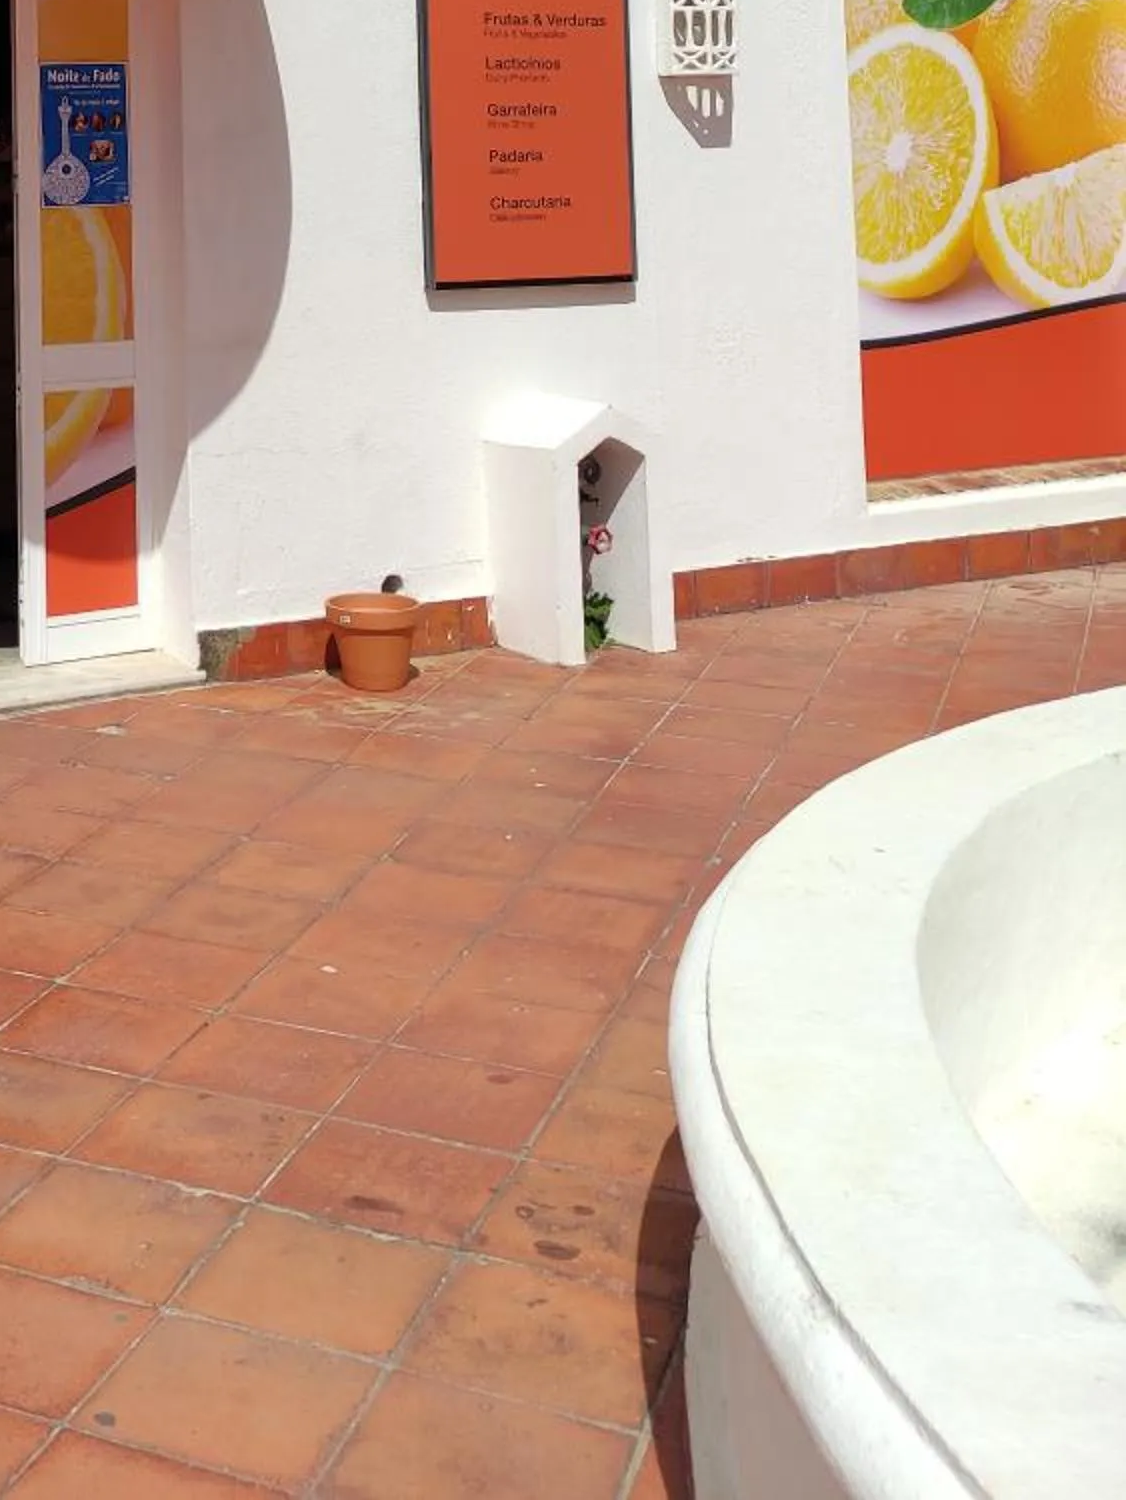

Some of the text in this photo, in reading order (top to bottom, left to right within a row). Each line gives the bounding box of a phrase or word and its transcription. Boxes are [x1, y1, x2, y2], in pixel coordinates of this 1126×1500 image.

[483, 11, 607, 28] Frutas & Verduras
[47, 69, 79, 83] Noite
[92, 68, 121, 83] Fado
[487, 103, 557, 118] Garrafeira
[489, 149, 544, 163] Padaria
